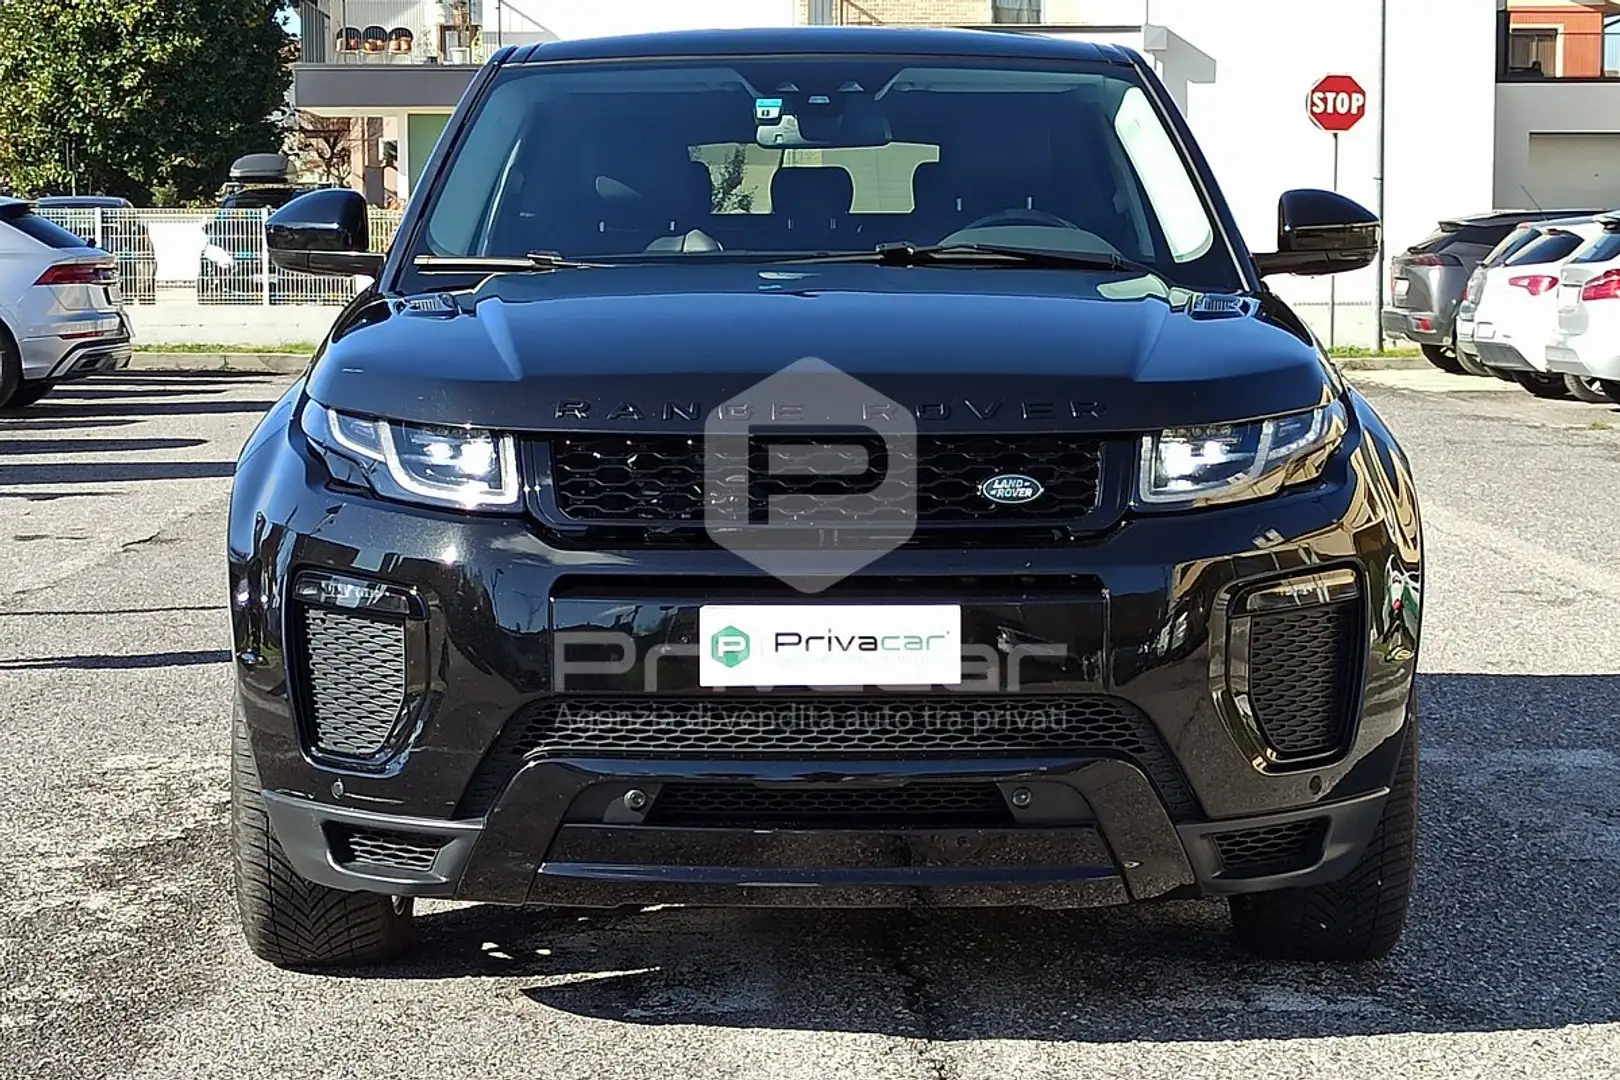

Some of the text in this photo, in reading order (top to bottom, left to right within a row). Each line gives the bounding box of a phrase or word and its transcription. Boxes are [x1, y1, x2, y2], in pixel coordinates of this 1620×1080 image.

[1312, 91, 1364, 115] STOP
[554, 400, 1106, 420] RANGE ROVER
[993, 479, 1024, 489] LAND
[996, 487, 1033, 498] ROVER
[774, 628, 946, 653] Privacar
